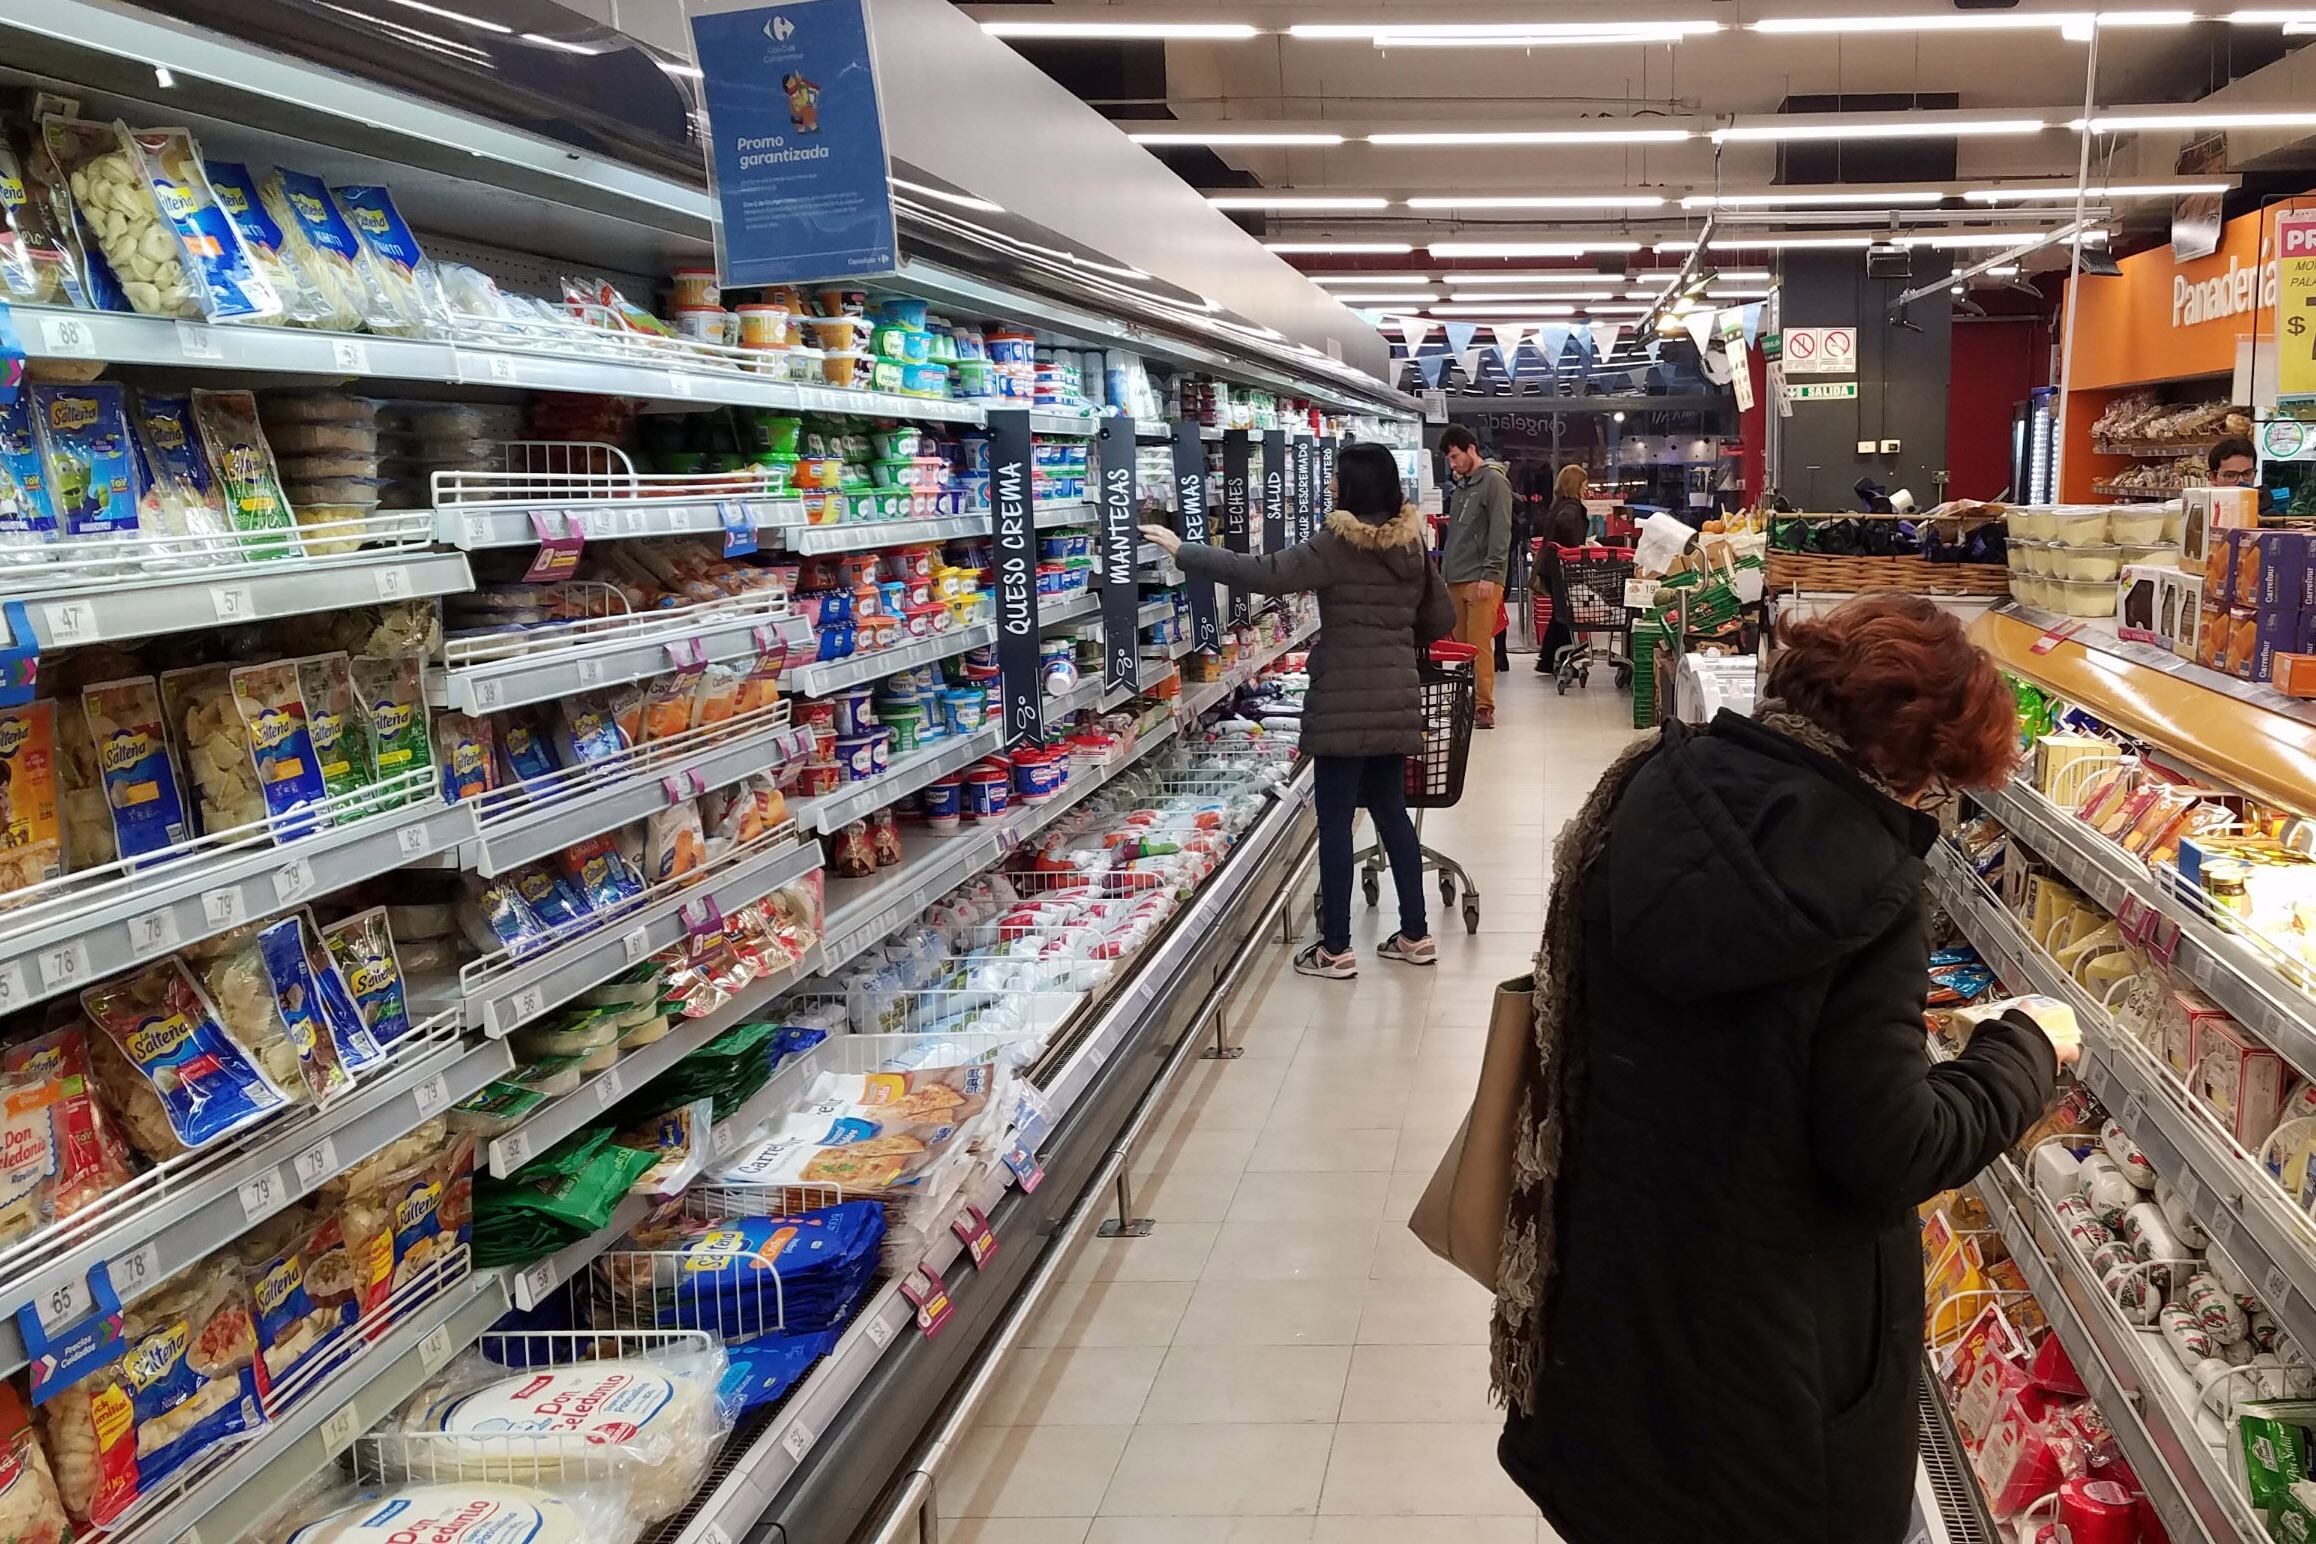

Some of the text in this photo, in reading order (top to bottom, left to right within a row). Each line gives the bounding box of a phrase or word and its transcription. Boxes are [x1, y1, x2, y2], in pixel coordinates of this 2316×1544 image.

[737, 136, 784, 151] Promo
[740, 145, 829, 169] garantizada
[1807, 386, 1848, 396] SALIDA
[1298, 443, 1309, 513] DESCREMADO
[1181, 473, 1205, 545] REMAS
[1228, 477, 1245, 534] LECHES
[1267, 472, 1282, 520] SALUD
[1107, 467, 1133, 584] MANTECAS
[998, 461, 1032, 636] QUESO CREMA
[2265, 565, 2274, 603] Carrefour
[2305, 567, 2314, 605] Carrefour
[2259, 640, 2271, 678] Carrefour
[106, 742, 146, 770] Salteña
[285, 865, 300, 888] 79
[135, 1021, 187, 1059] Salteña
[4, 1127, 32, 1150] Don
[308, 1149, 324, 1174] 79
[253, 1179, 270, 1203] 79
[125, 1255, 145, 1281] 78
[51, 1286, 71, 1314] 65
[257, 1265, 299, 1309] Salteña
[534, 1391, 580, 1415] Don
